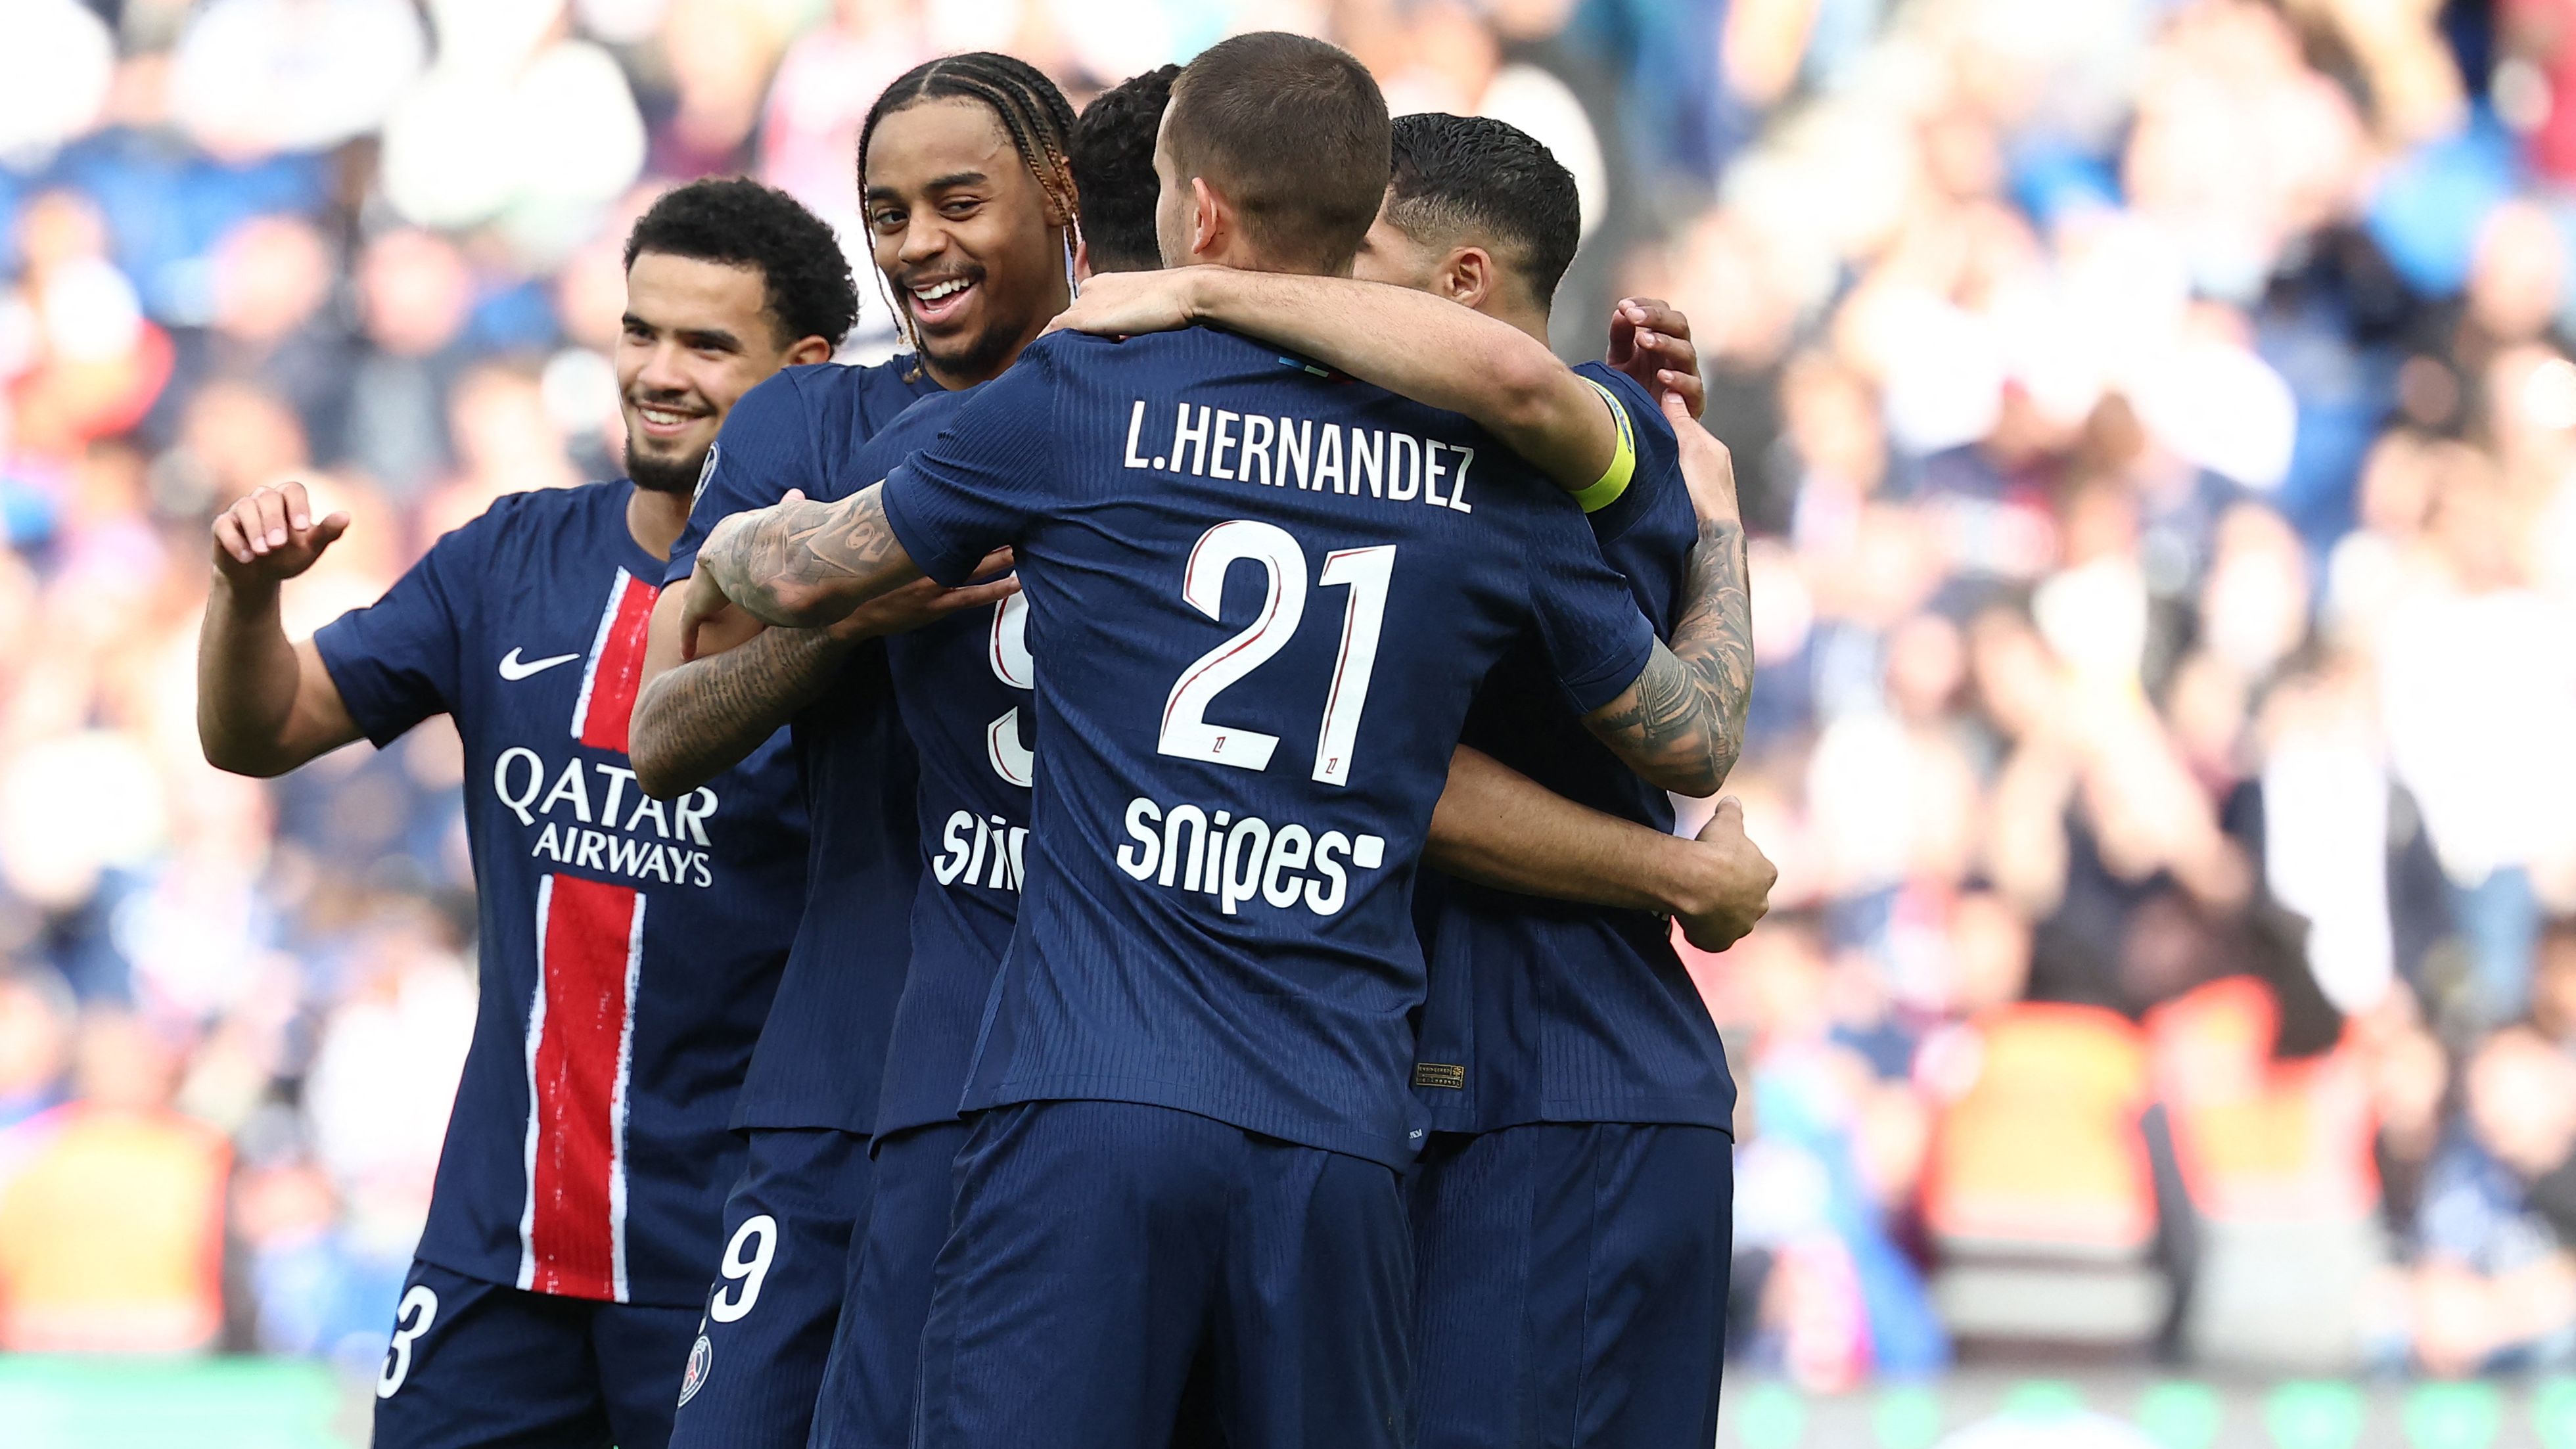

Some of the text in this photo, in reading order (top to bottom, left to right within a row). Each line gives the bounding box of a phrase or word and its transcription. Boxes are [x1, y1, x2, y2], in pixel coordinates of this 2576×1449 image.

[1124, 400, 1474, 514] L.HERNANDEZ
[1157, 519, 1397, 787] 21
[494, 747, 719, 846] QATAR
[532, 822, 714, 888] AIRWAYS
[1116, 797, 1352, 916] snipes
